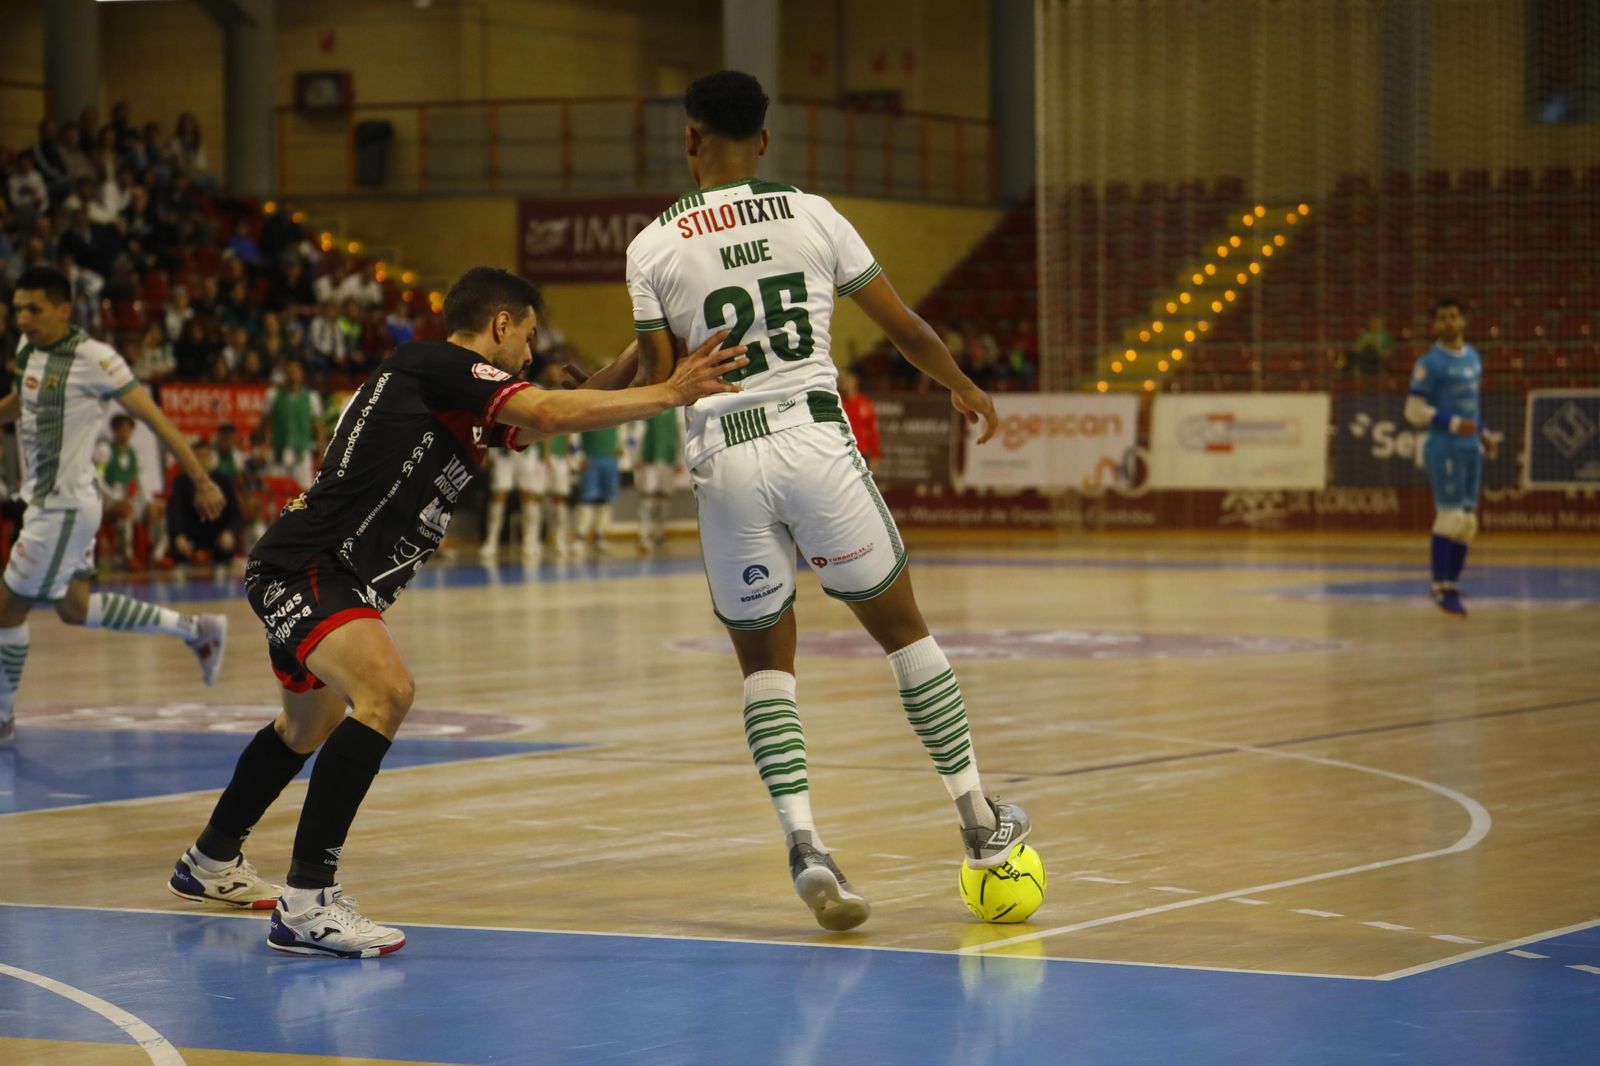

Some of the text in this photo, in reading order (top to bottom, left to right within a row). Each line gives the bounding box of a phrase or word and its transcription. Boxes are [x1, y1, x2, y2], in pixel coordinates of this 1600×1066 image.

[677, 194, 795, 240] STILOTEXTIL
[719, 238, 773, 270] KAUE
[703, 271, 816, 384] 25
[740, 582, 783, 603] ROSMARINO
